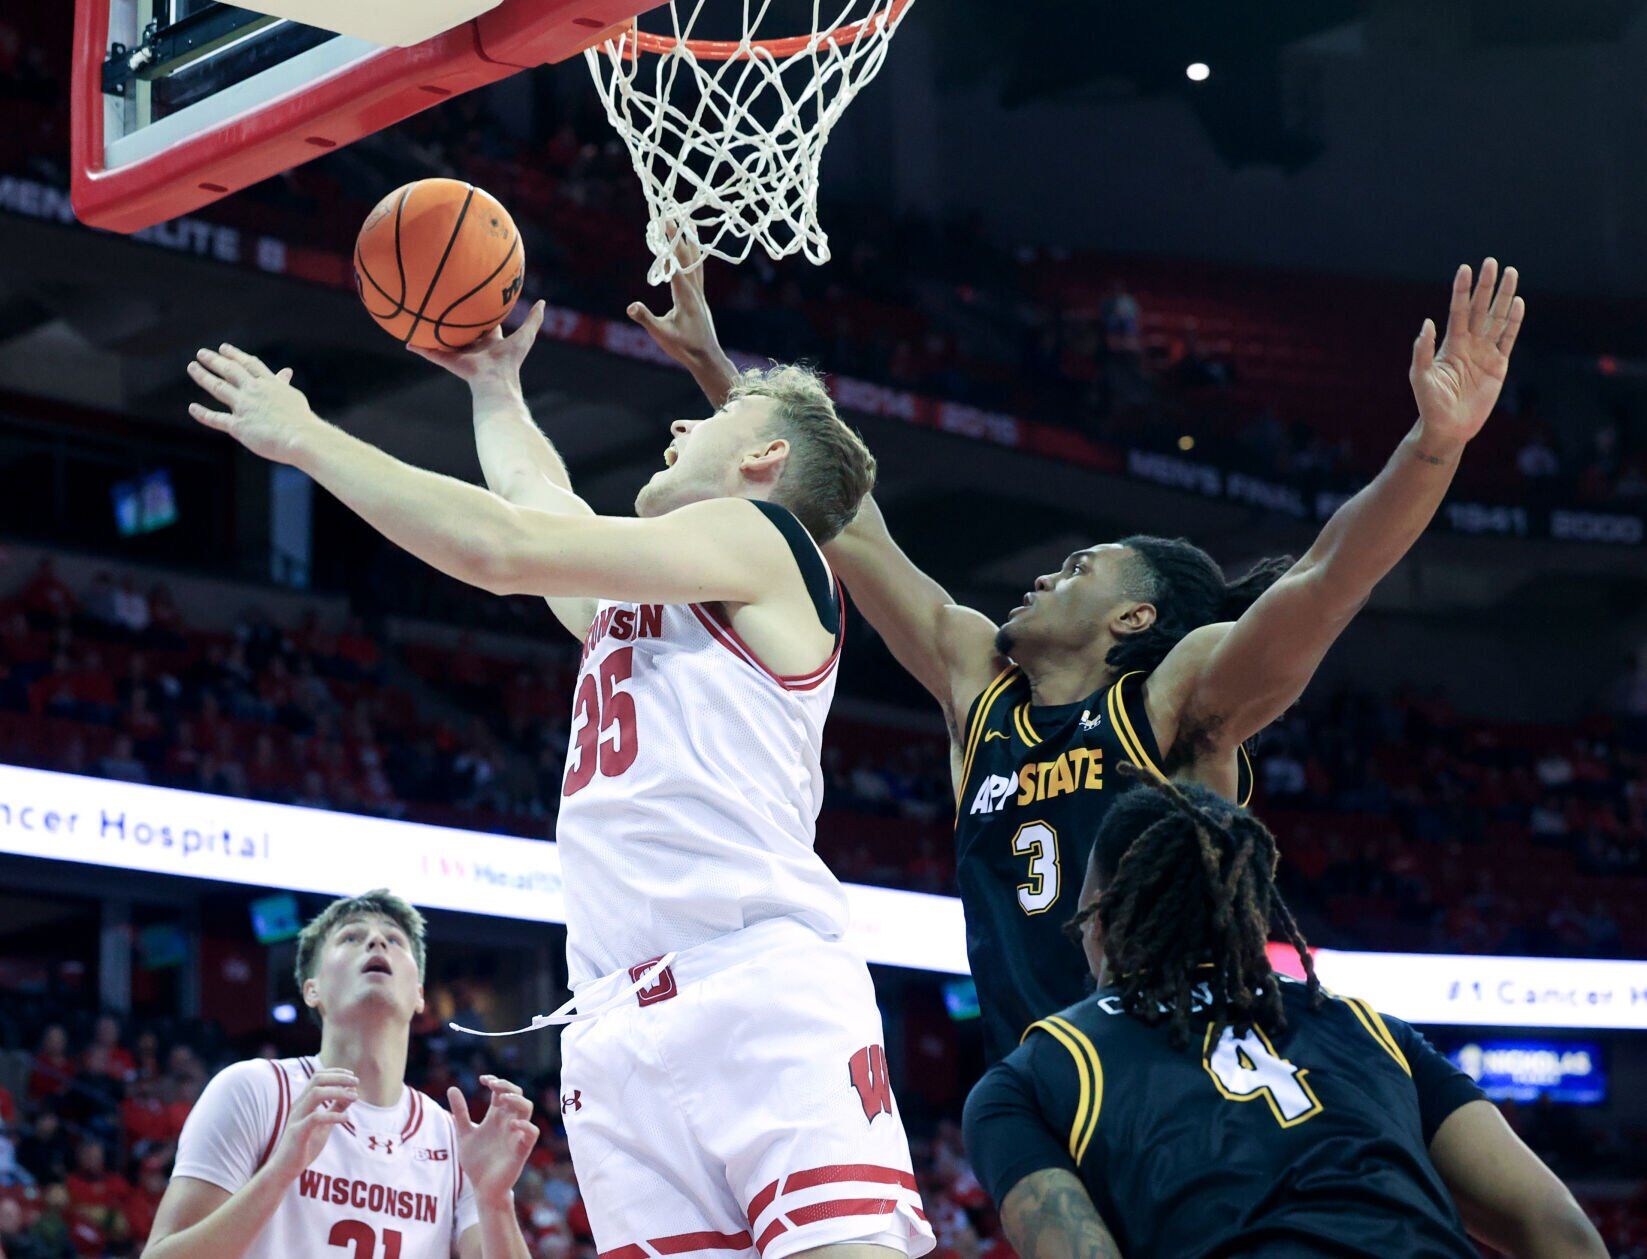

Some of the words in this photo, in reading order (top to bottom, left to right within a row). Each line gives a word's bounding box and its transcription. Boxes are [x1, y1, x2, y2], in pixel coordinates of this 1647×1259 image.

[563, 645, 638, 797] 35
[100, 809, 271, 859] Hospital
[1011, 819, 1061, 916] 3
[1497, 980, 1614, 1007] Cancer
[1202, 1020, 1324, 1129] 4
[299, 1169, 438, 1225] WISCONSIN
